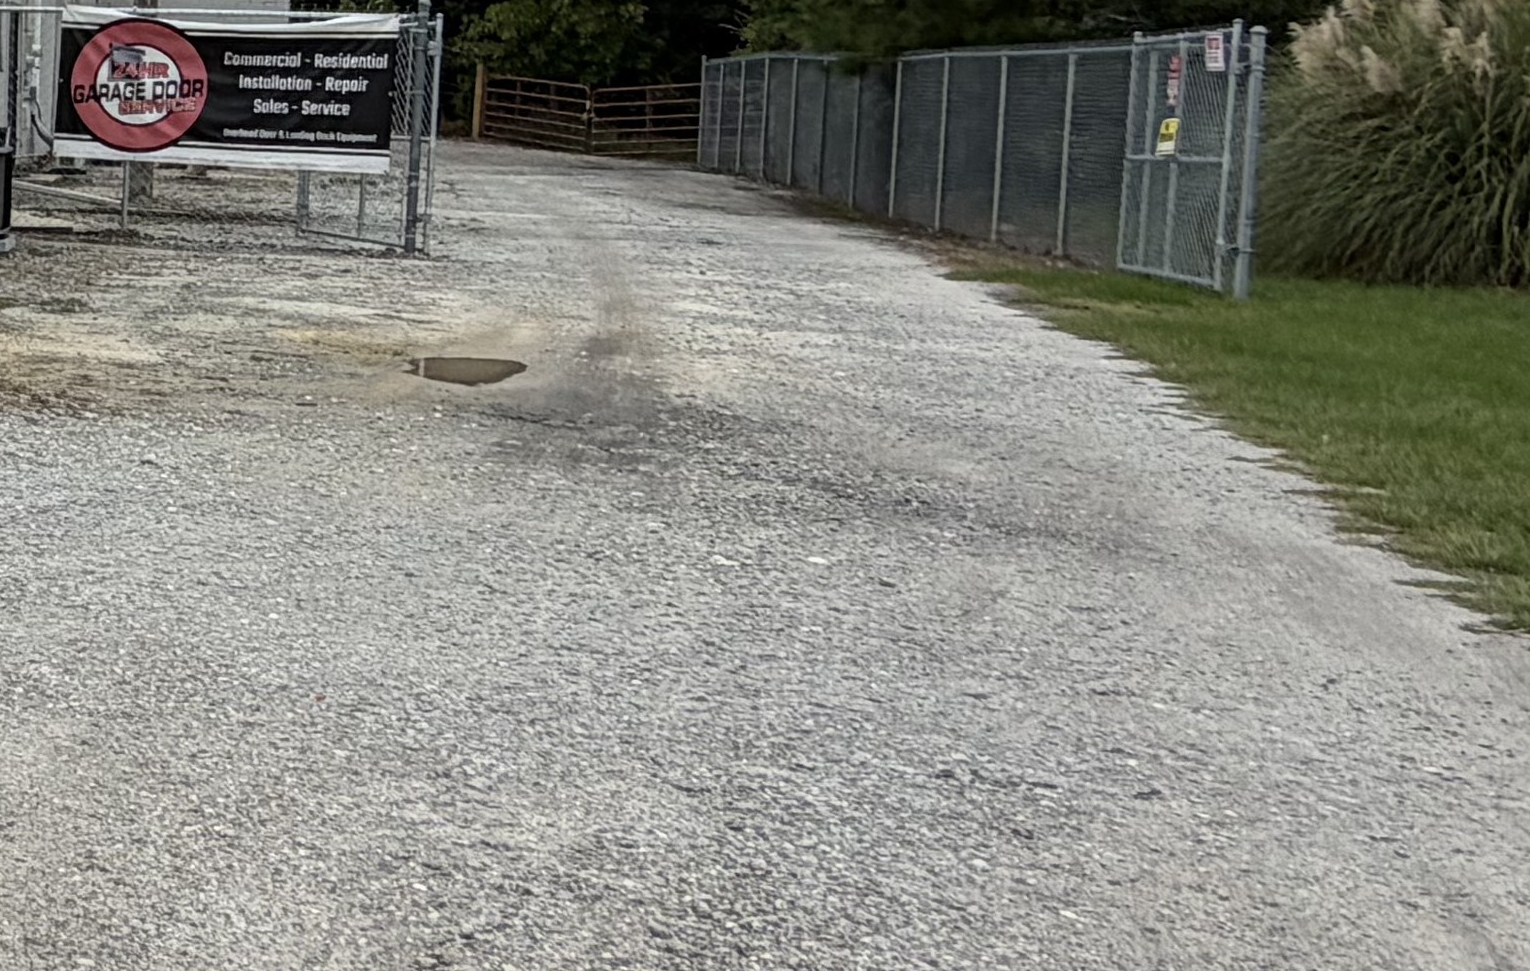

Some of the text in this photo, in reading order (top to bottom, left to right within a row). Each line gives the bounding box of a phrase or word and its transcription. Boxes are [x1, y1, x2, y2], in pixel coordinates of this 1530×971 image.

[223, 51, 302, 68] Commercial
[314, 52, 388, 69] Residential
[73, 78, 204, 103] GARAGE DOOR
[239, 74, 312, 91] Installation
[325, 76, 369, 95] Repair
[118, 97, 197, 115] SERVICE
[253, 98, 289, 115] Sales
[301, 100, 351, 116] Service
